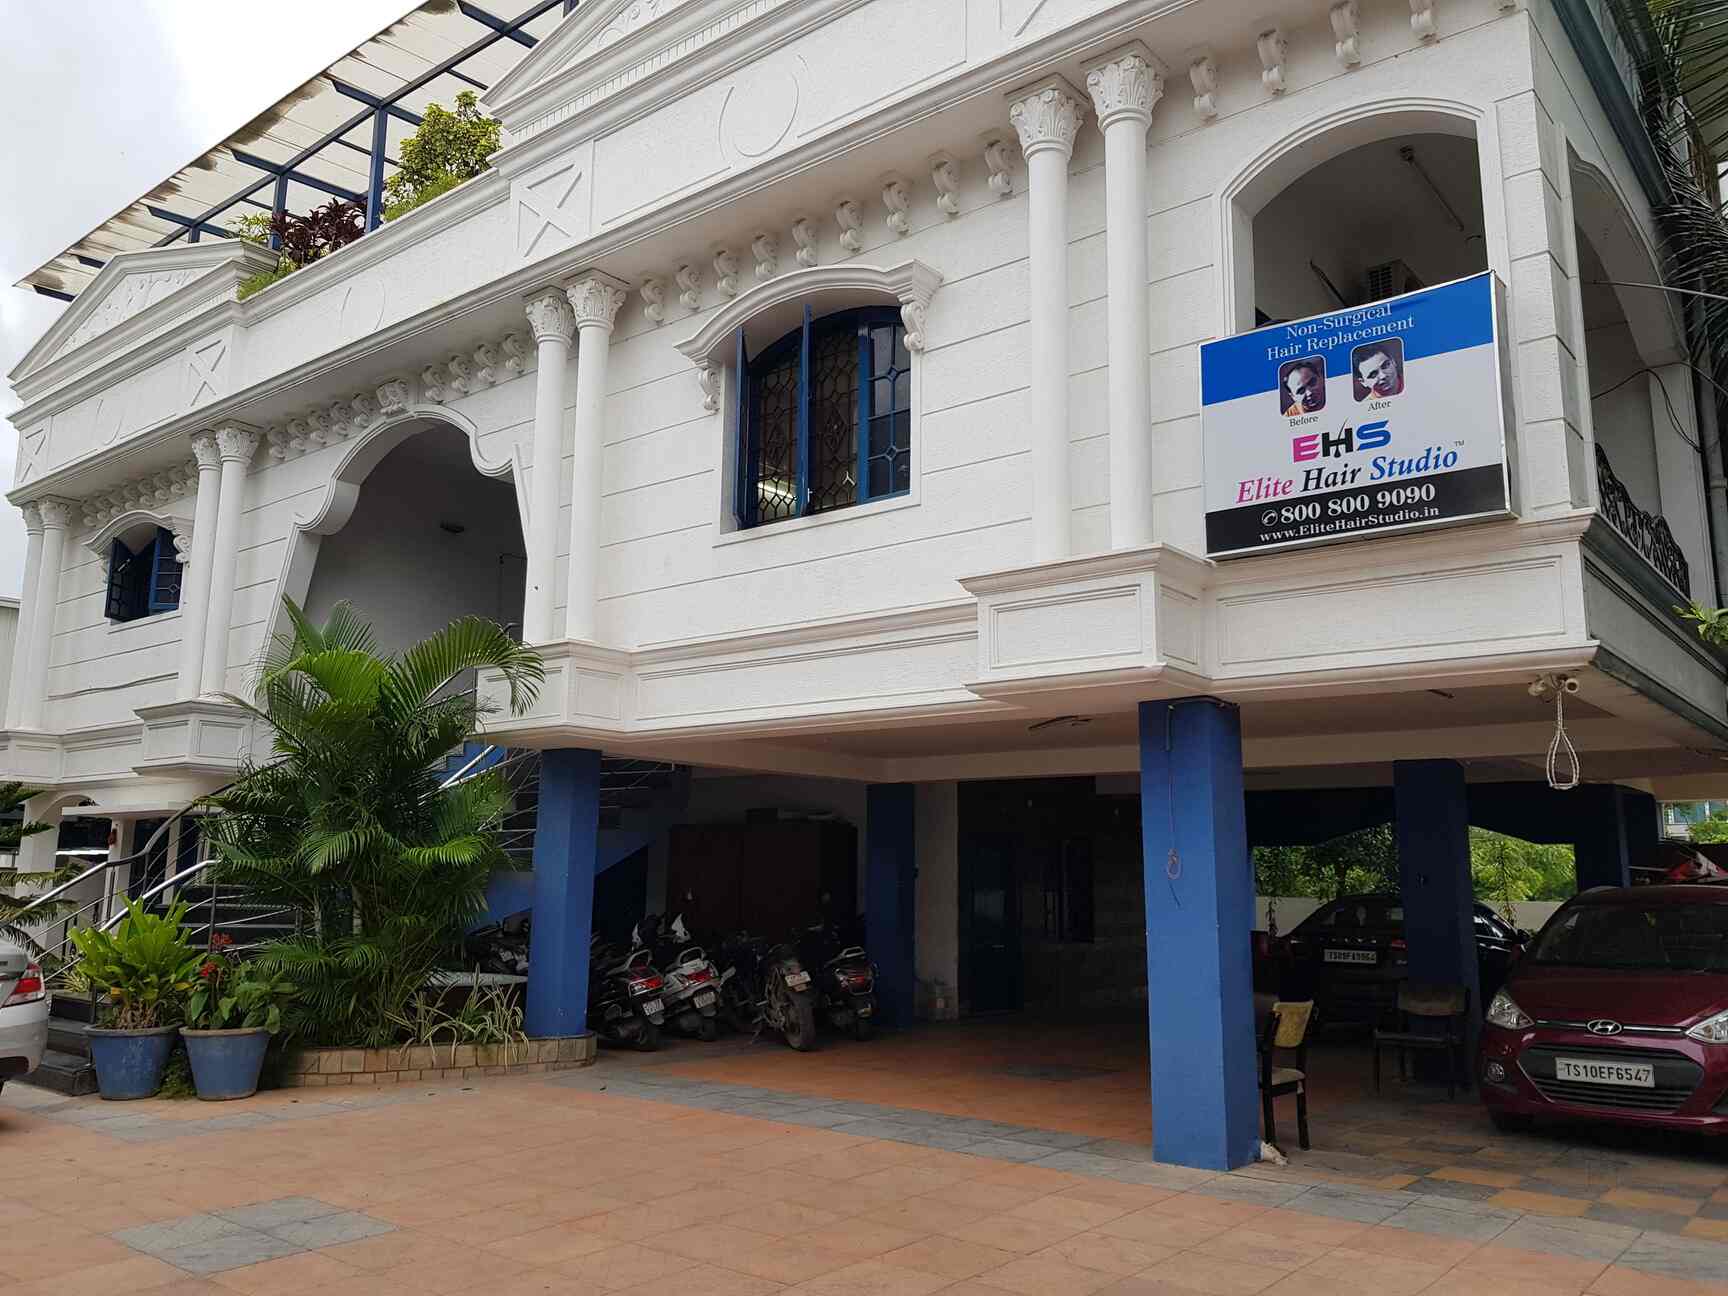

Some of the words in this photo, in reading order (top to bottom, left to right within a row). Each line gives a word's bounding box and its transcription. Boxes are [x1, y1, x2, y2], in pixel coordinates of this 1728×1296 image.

[1266, 343, 1302, 361] Hair
[1307, 312, 1415, 351] Replacement
[1286, 303, 1392, 339] Non-Surgical
[1289, 415, 1319, 427] Before
[1367, 400, 1392, 411] After
[1292, 419, 1391, 463] EHS
[1235, 477, 1294, 504] Elite
[1300, 463, 1362, 493] Hair
[1369, 445, 1458, 481] Studio
[1280, 502, 1321, 524] 800
[1327, 494, 1369, 517] 800
[1376, 483, 1436, 509] 9090
[1259, 506, 1440, 542] www.EliteHairStudio.in
[1564, 1063, 1650, 1082] TS10EF6547
